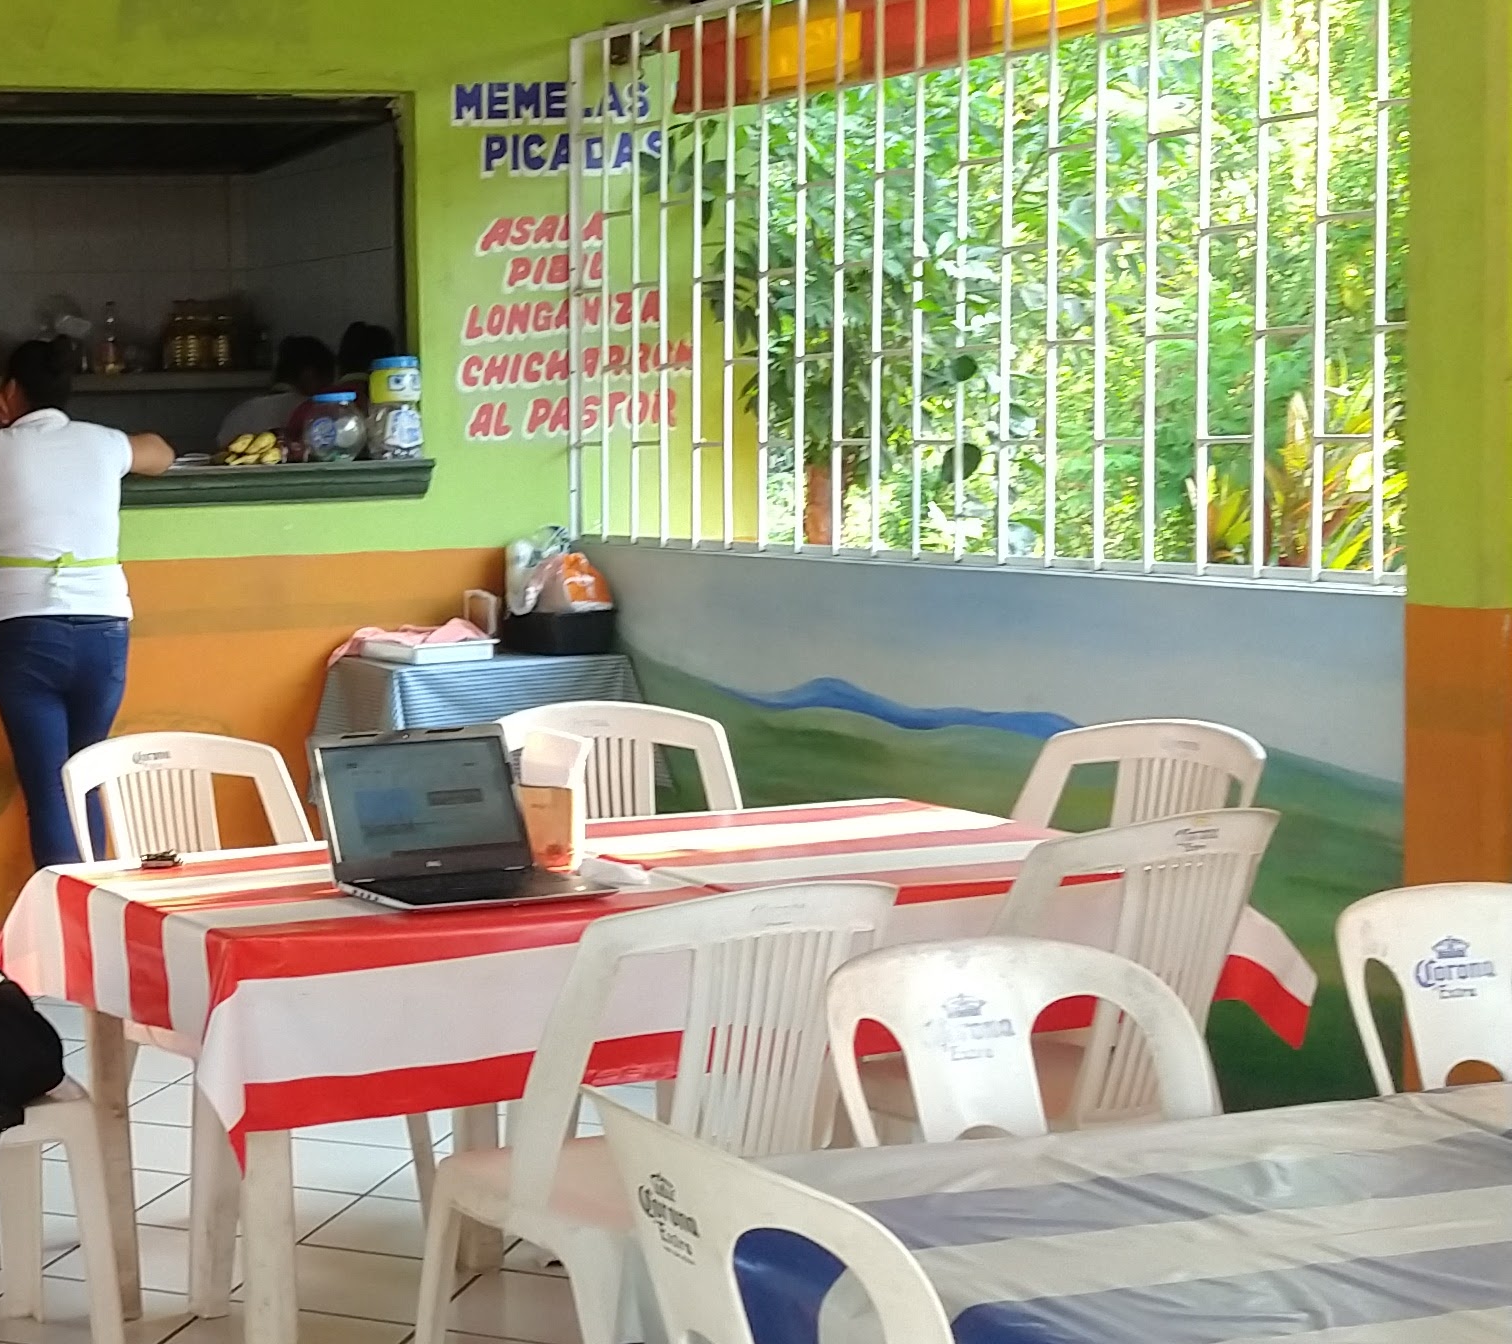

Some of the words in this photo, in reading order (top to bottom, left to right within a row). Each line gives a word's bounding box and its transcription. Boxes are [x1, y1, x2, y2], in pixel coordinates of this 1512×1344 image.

[453, 81, 649, 124] MEMEAS
[505, 250, 603, 289] PIBL
[464, 291, 660, 341] LONGANZA
[468, 401, 512, 438] AL
